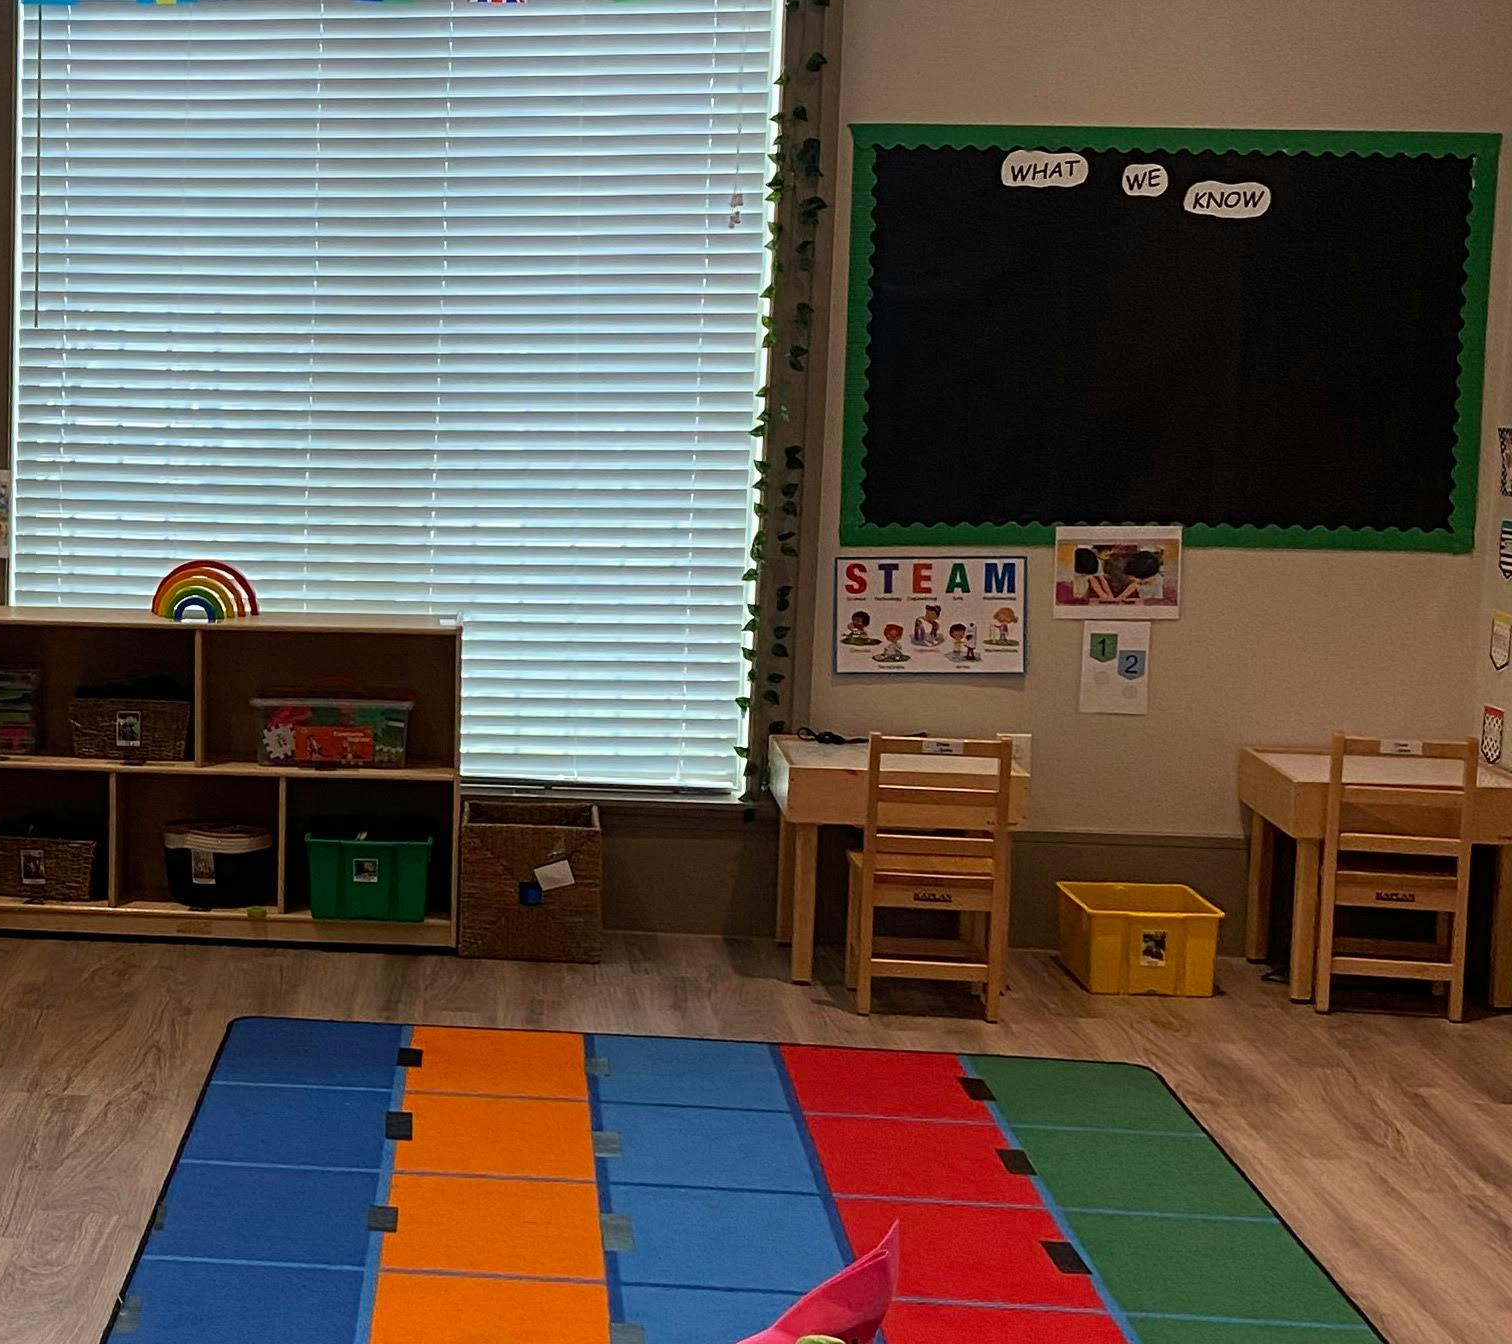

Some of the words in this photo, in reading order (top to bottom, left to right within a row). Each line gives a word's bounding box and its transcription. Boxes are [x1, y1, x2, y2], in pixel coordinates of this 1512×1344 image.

[1009, 160, 1081, 183] WHAT
[1125, 168, 1162, 191] WE
[1191, 189, 1265, 211] KNOW
[844, 562, 1017, 595] STEAM
[1097, 637, 1107, 658] 1
[1124, 654, 1139, 675] 2
